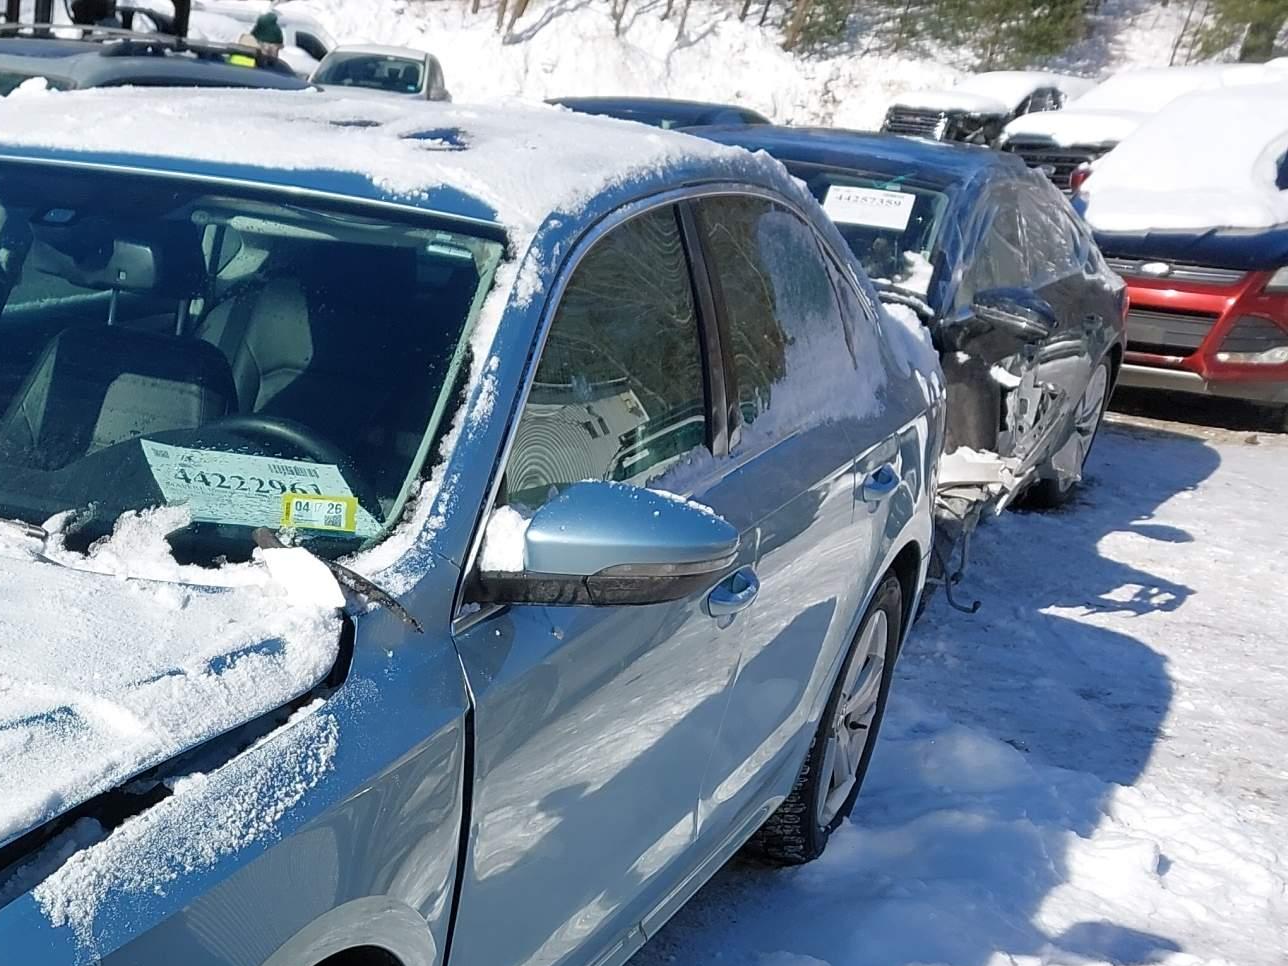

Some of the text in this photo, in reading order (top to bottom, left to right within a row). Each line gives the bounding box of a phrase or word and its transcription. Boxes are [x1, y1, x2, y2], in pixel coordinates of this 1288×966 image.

[174, 468, 322, 496] 44222961
[295, 500, 310, 512] 04
[326, 502, 342, 514] 26
